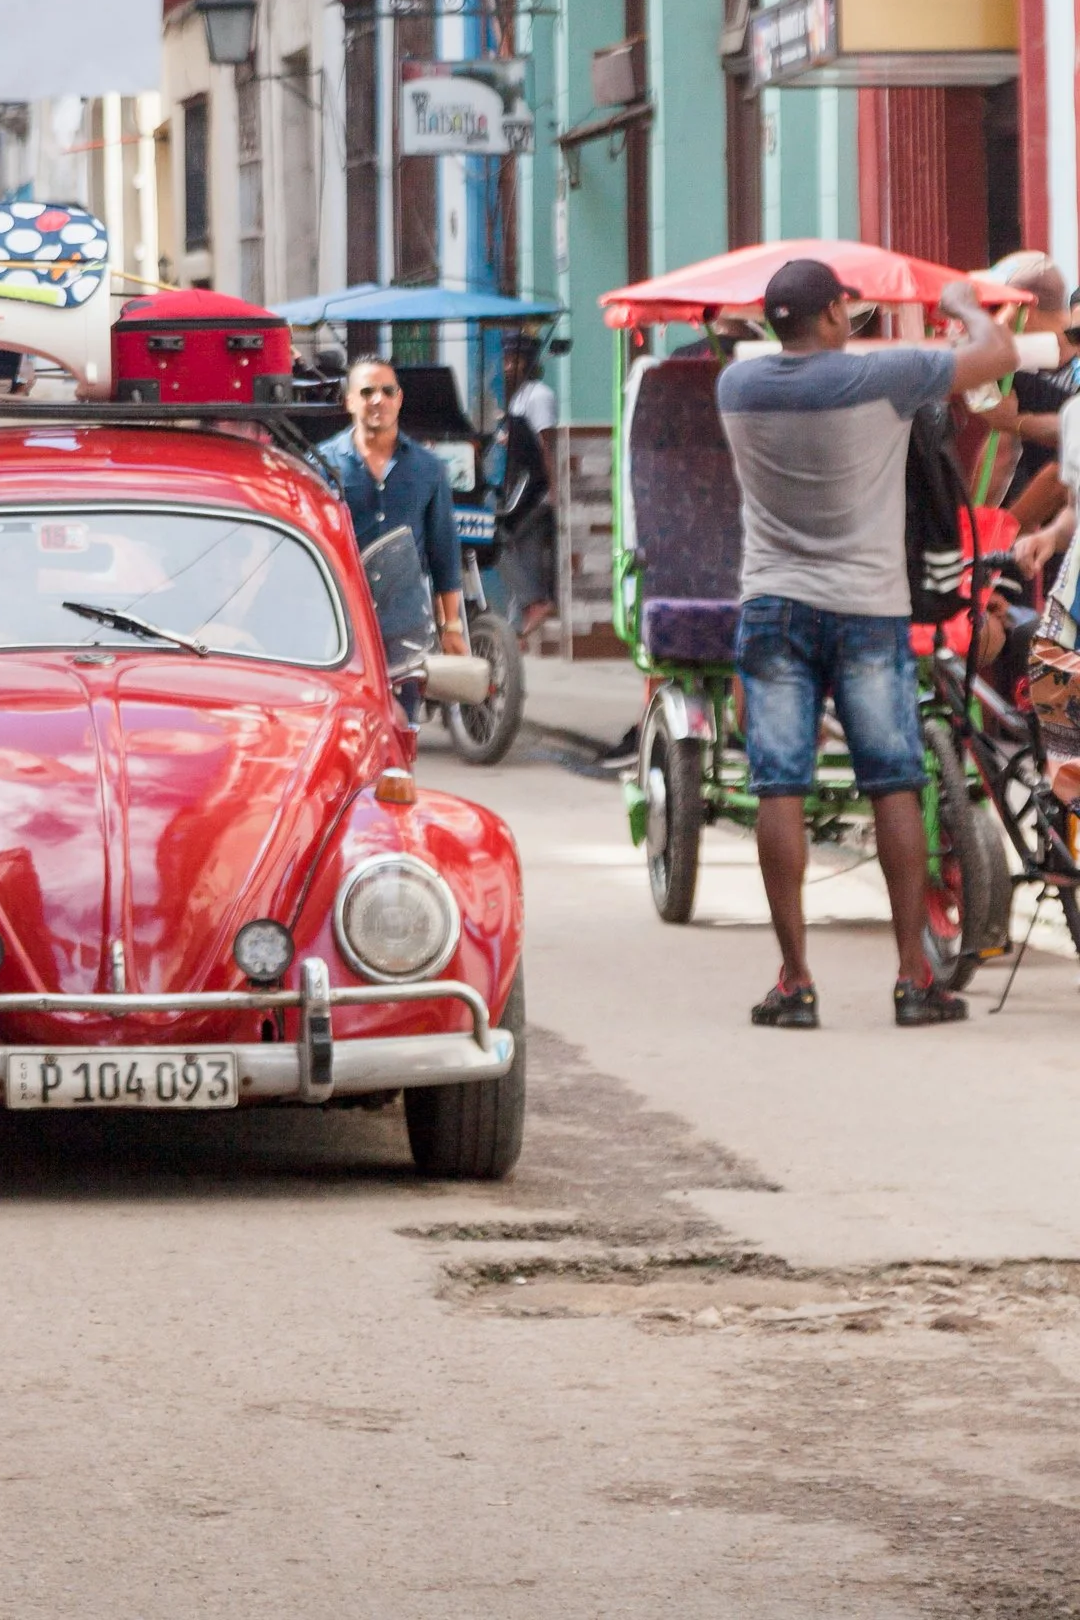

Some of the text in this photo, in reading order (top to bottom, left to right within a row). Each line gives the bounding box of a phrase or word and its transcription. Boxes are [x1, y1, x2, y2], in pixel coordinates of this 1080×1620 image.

[40, 1061, 229, 1103] P 104 093
